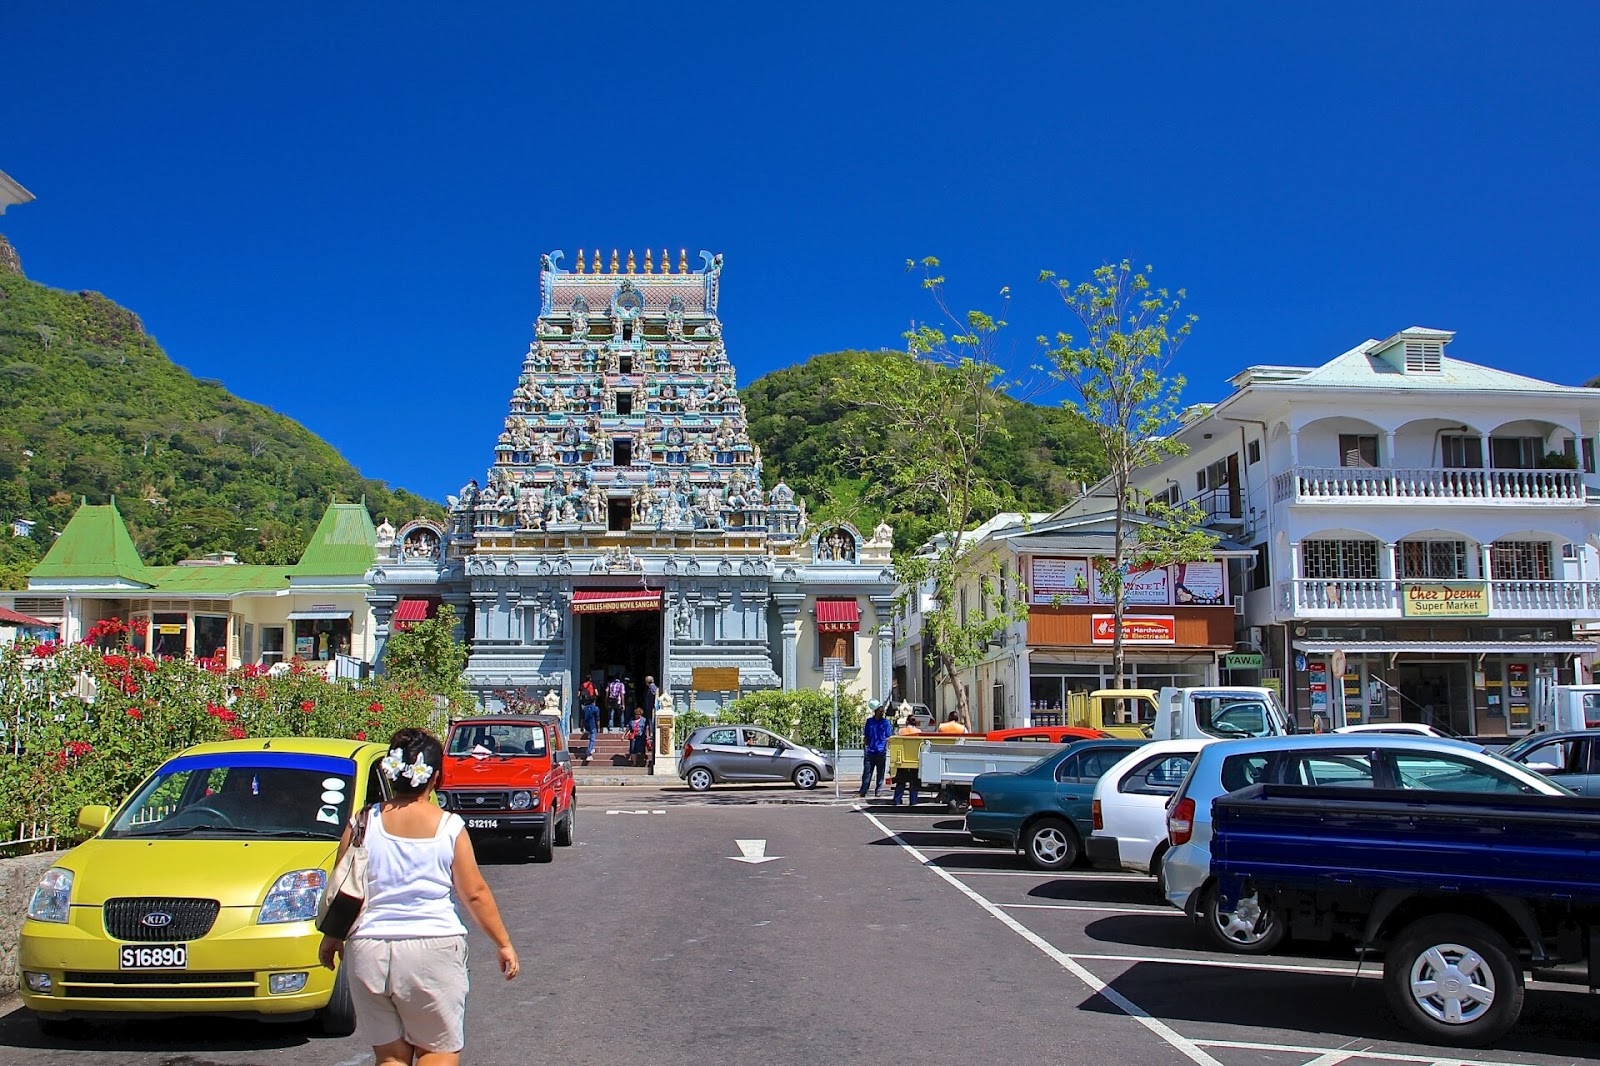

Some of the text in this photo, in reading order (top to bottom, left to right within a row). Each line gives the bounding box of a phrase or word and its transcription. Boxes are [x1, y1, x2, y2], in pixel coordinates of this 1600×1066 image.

[1410, 586, 1481, 601] Chez Deenu
[603, 602, 619, 610] HINDU
[1416, 601, 1478, 611] Super Market
[469, 820, 498, 828] S12114
[147, 916, 166, 924] KIA
[122, 948, 185, 967] S16890
